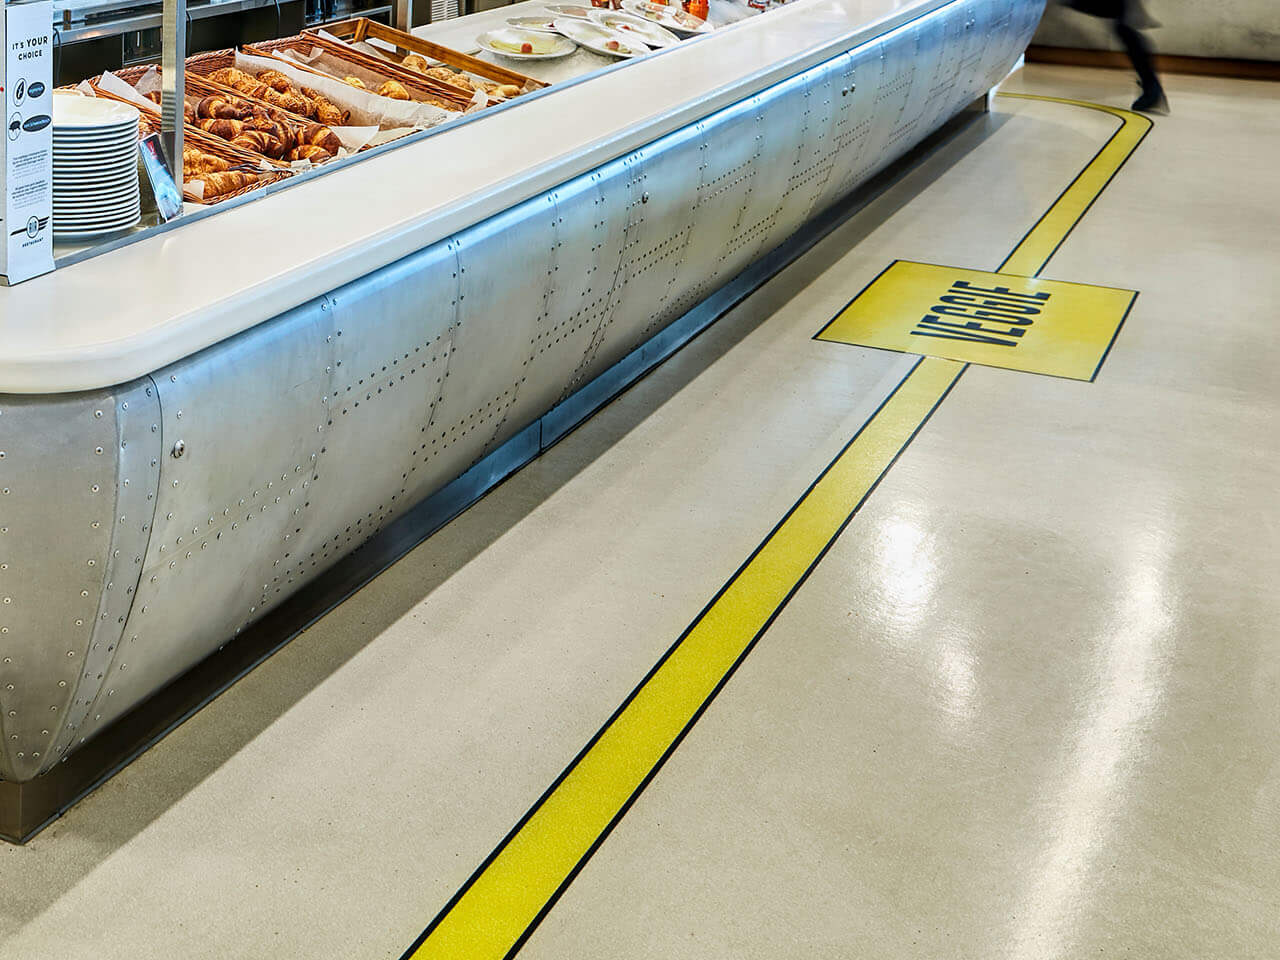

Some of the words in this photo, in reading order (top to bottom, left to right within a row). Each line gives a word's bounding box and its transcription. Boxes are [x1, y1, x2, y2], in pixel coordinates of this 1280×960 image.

[12, 42, 24, 51] IT'S
[26, 36, 48, 48] YOUR
[18, 49, 42, 61] CHOICE
[909, 280, 1053, 347] VEGGIE
